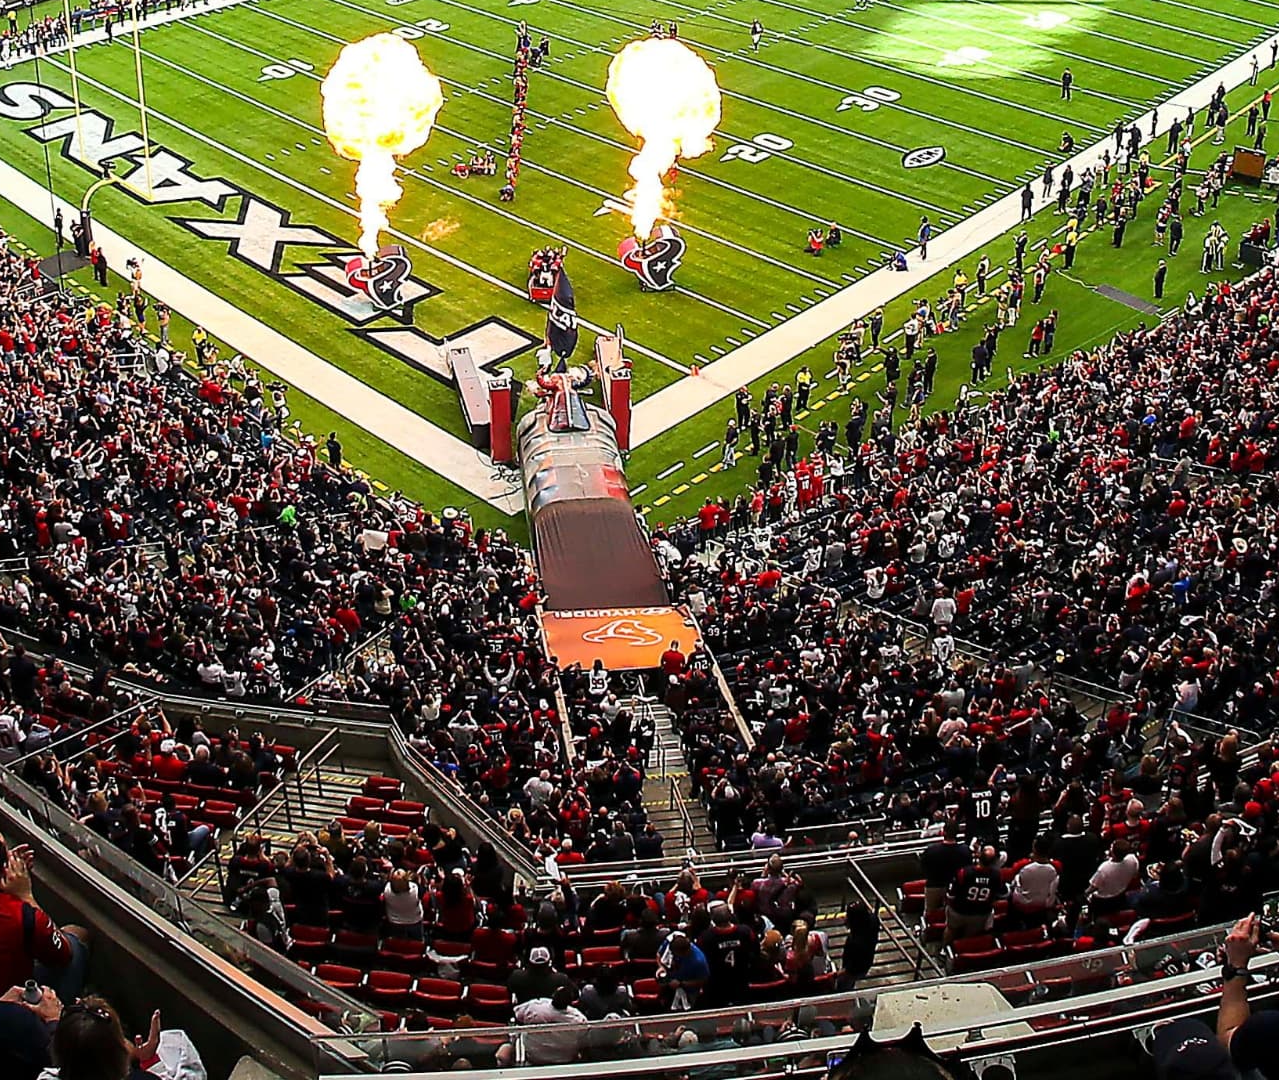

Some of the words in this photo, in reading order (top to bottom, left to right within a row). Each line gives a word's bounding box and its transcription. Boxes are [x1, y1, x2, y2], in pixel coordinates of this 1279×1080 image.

[261, 58, 315, 80] 10
[840, 86, 902, 112] 30
[726, 133, 794, 164] 20
[553, 609, 637, 618] HYUNDAI
[975, 799, 991, 819] 10
[967, 886, 991, 902] 99
[724, 950, 735, 967] 4
